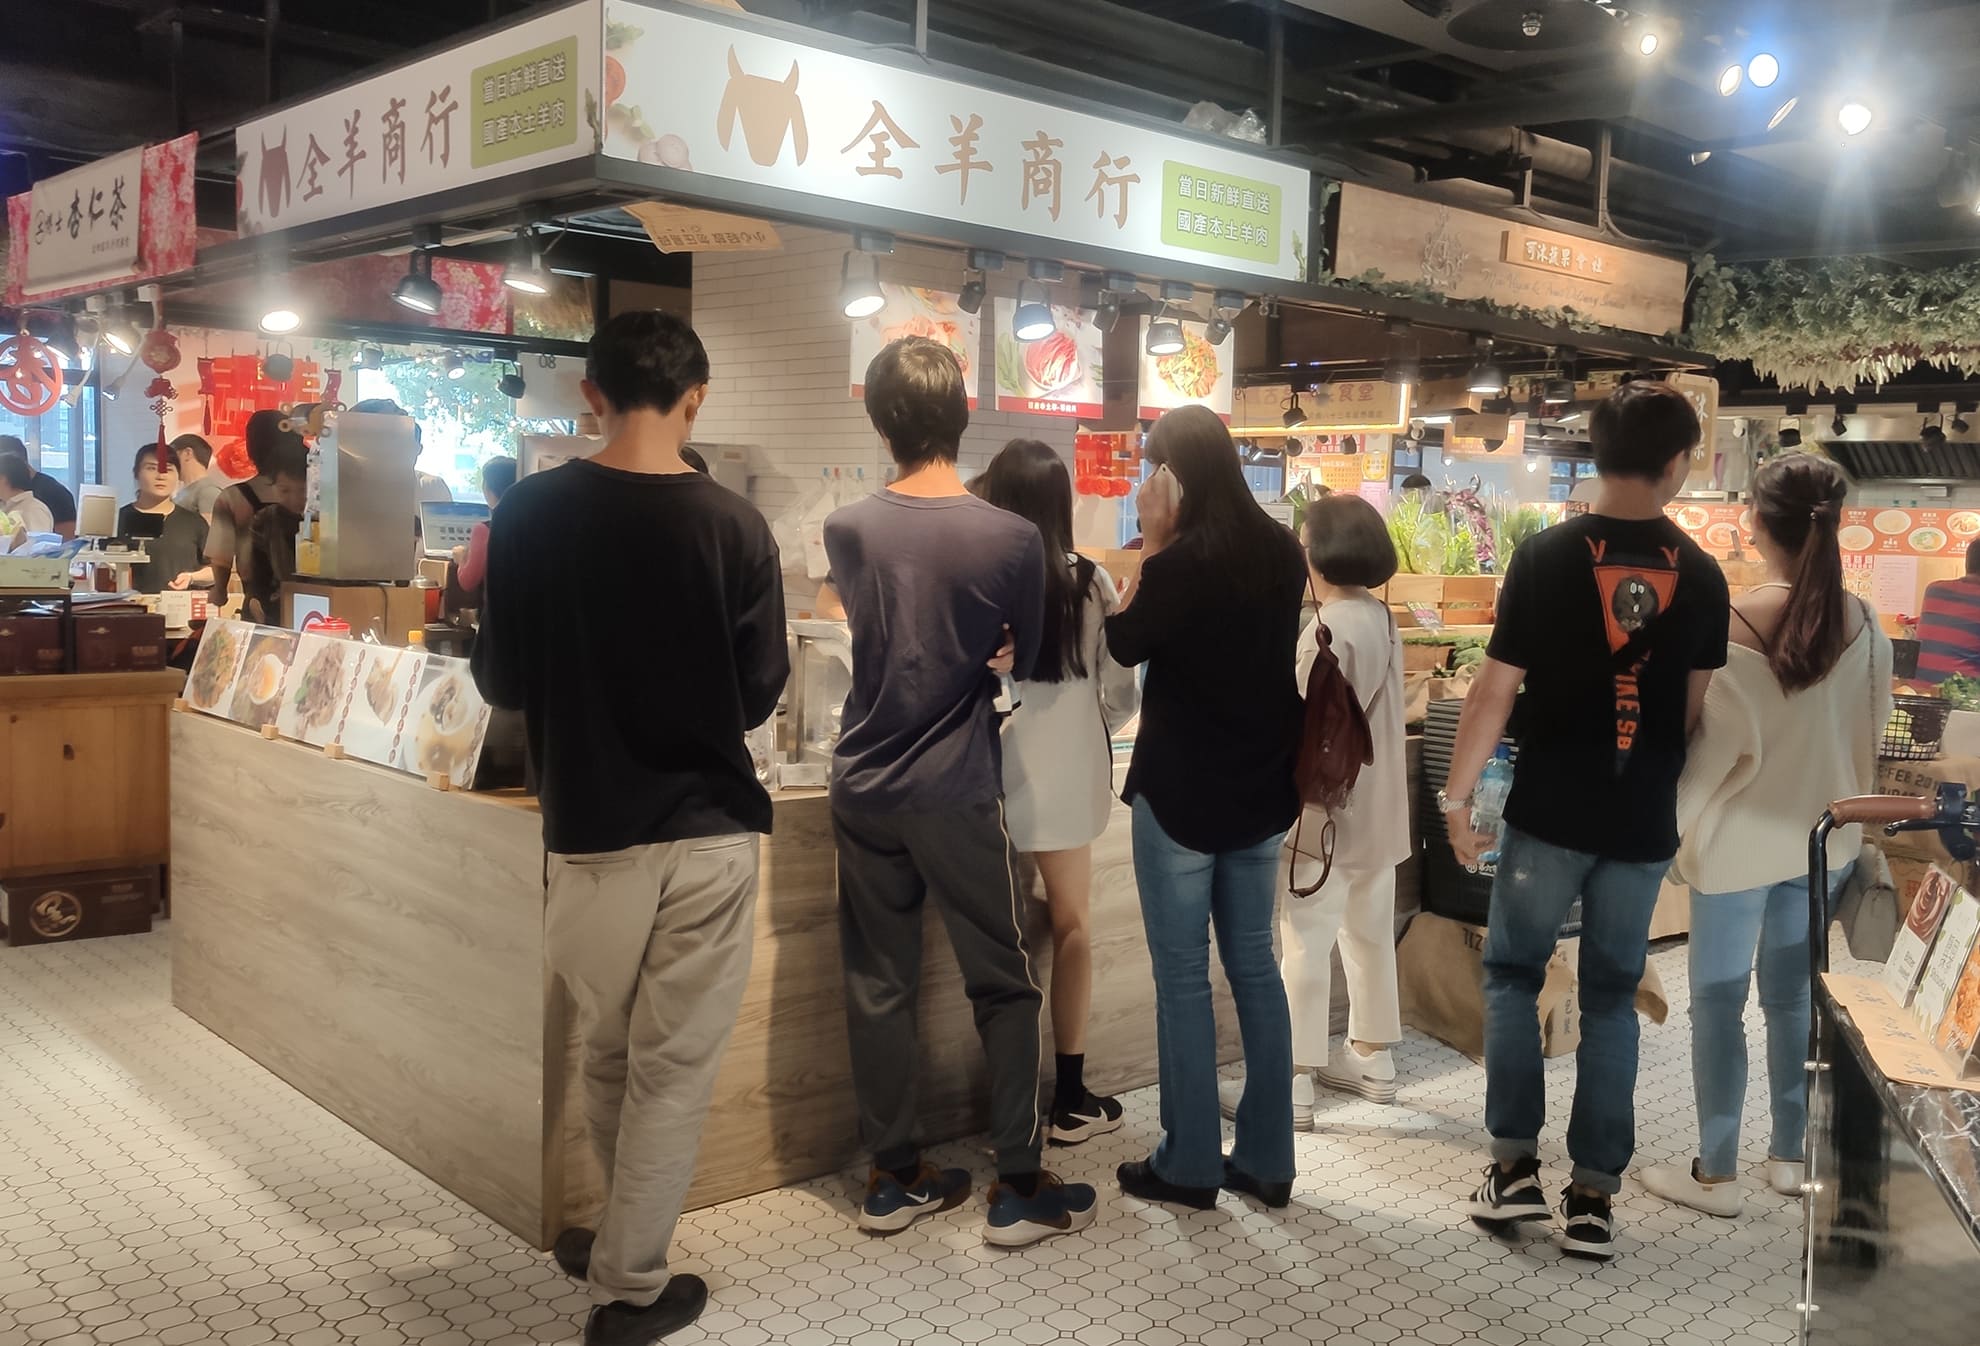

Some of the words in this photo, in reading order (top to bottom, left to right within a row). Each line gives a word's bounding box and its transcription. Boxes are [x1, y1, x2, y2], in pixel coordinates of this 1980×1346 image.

[482, 52, 567, 105] 當日新鮮直送
[296, 85, 459, 202] 全羊商行
[482, 99, 566, 147] 國產本土羊肉
[840, 100, 1141, 230] 全羊商行
[1178, 175, 1271, 214] 當日新鮮直送
[1177, 209, 1269, 247] 國產本土羊肉
